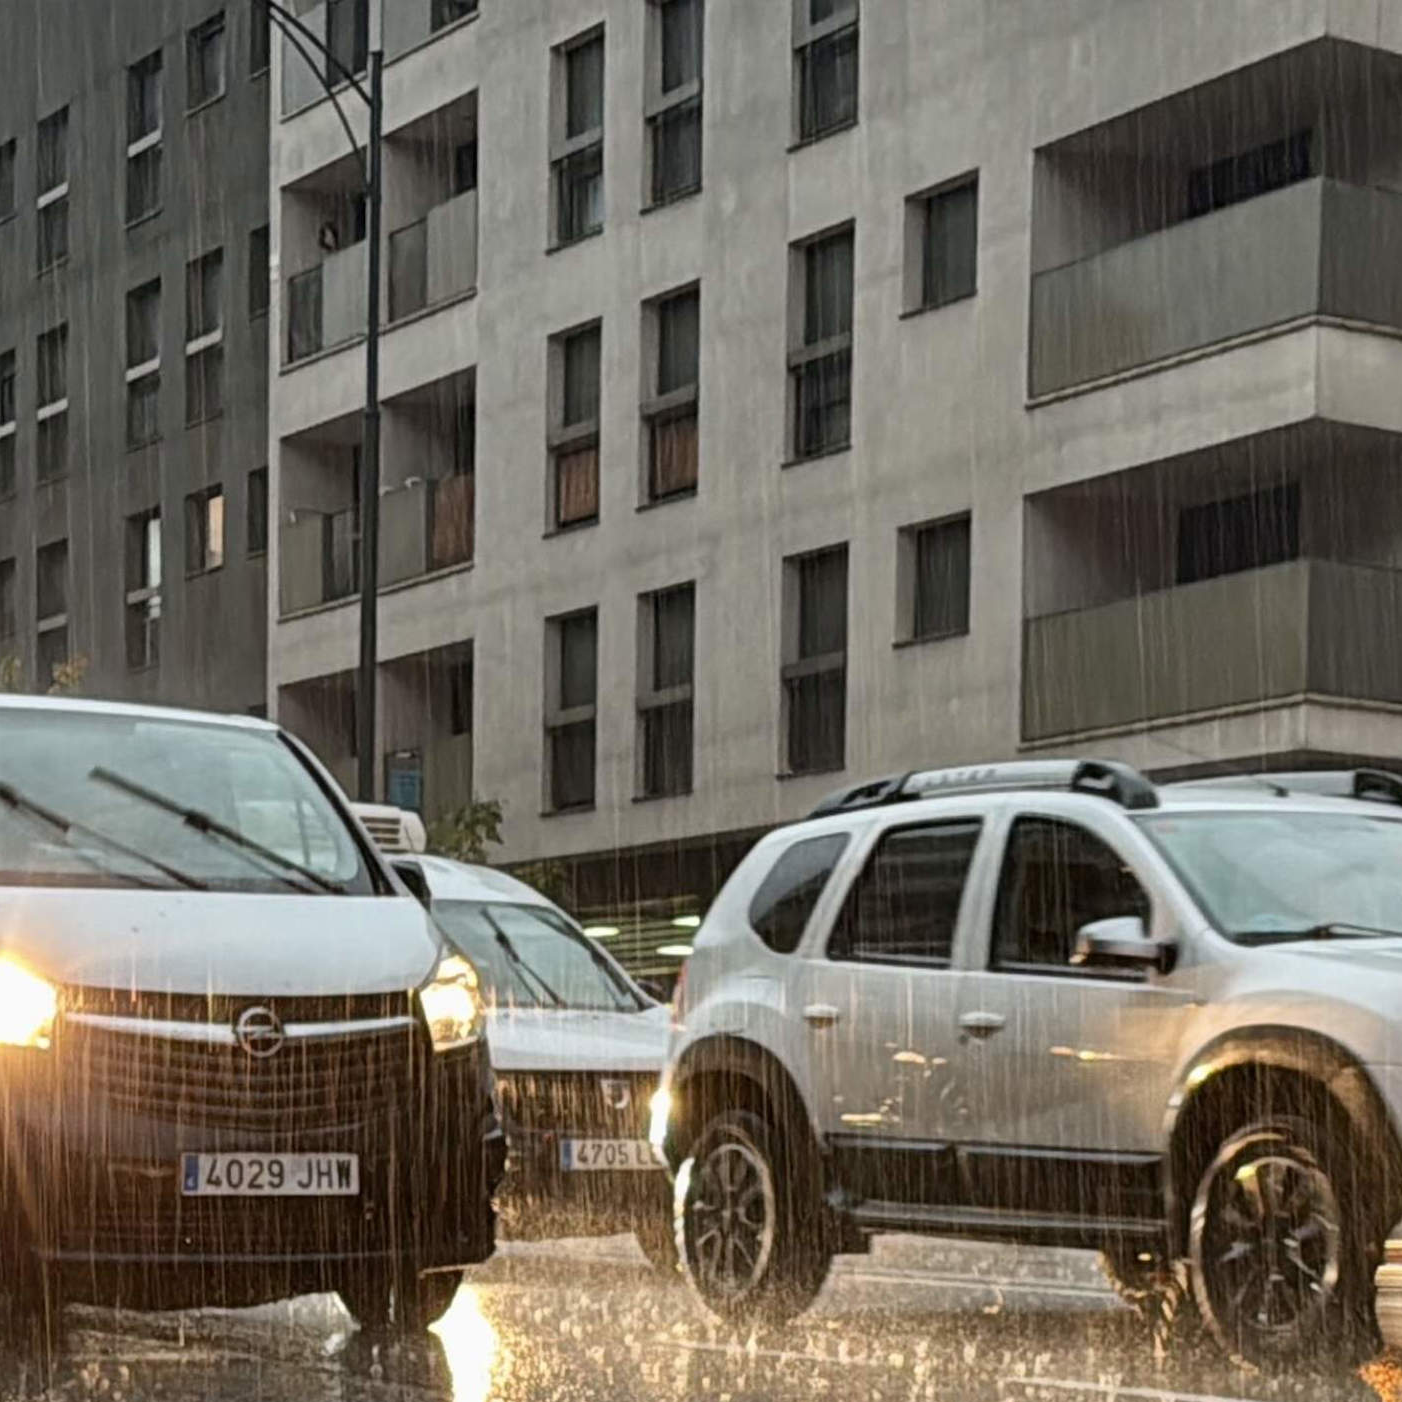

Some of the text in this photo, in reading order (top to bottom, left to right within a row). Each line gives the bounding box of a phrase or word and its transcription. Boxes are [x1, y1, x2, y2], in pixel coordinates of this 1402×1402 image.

[577, 1142, 629, 1166] 4705
[206, 1158, 352, 1190] 4029 JHW
